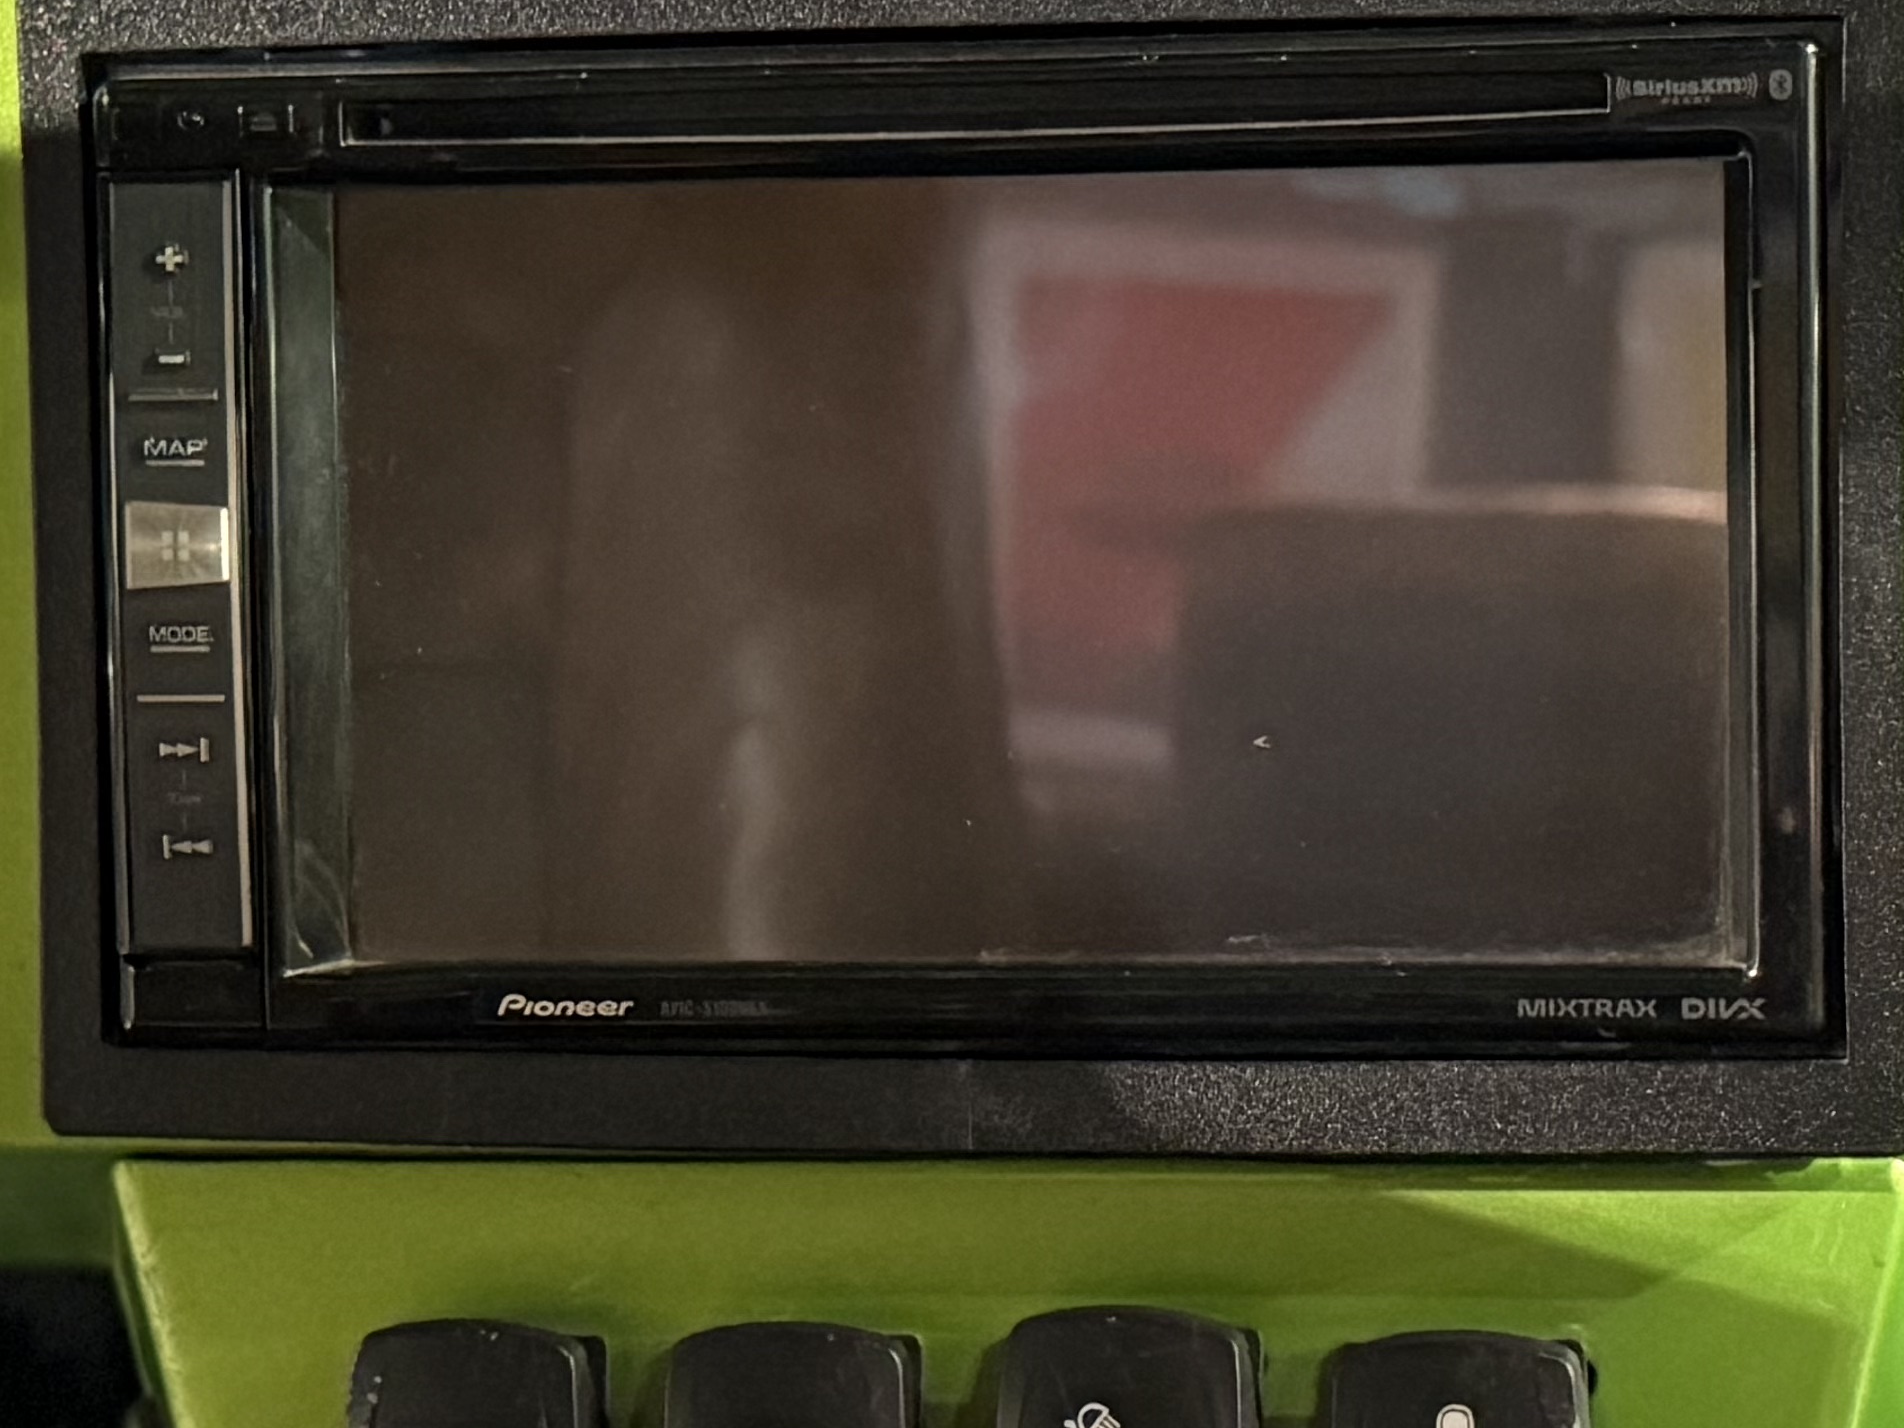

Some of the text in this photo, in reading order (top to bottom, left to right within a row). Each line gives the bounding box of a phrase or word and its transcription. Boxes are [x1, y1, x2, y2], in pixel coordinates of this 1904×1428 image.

[144, 439, 206, 456] MAP
[149, 625, 211, 642] MODE
[497, 993, 634, 1016] Pioneer
[1517, 998, 1657, 1018] MIXTRAX
